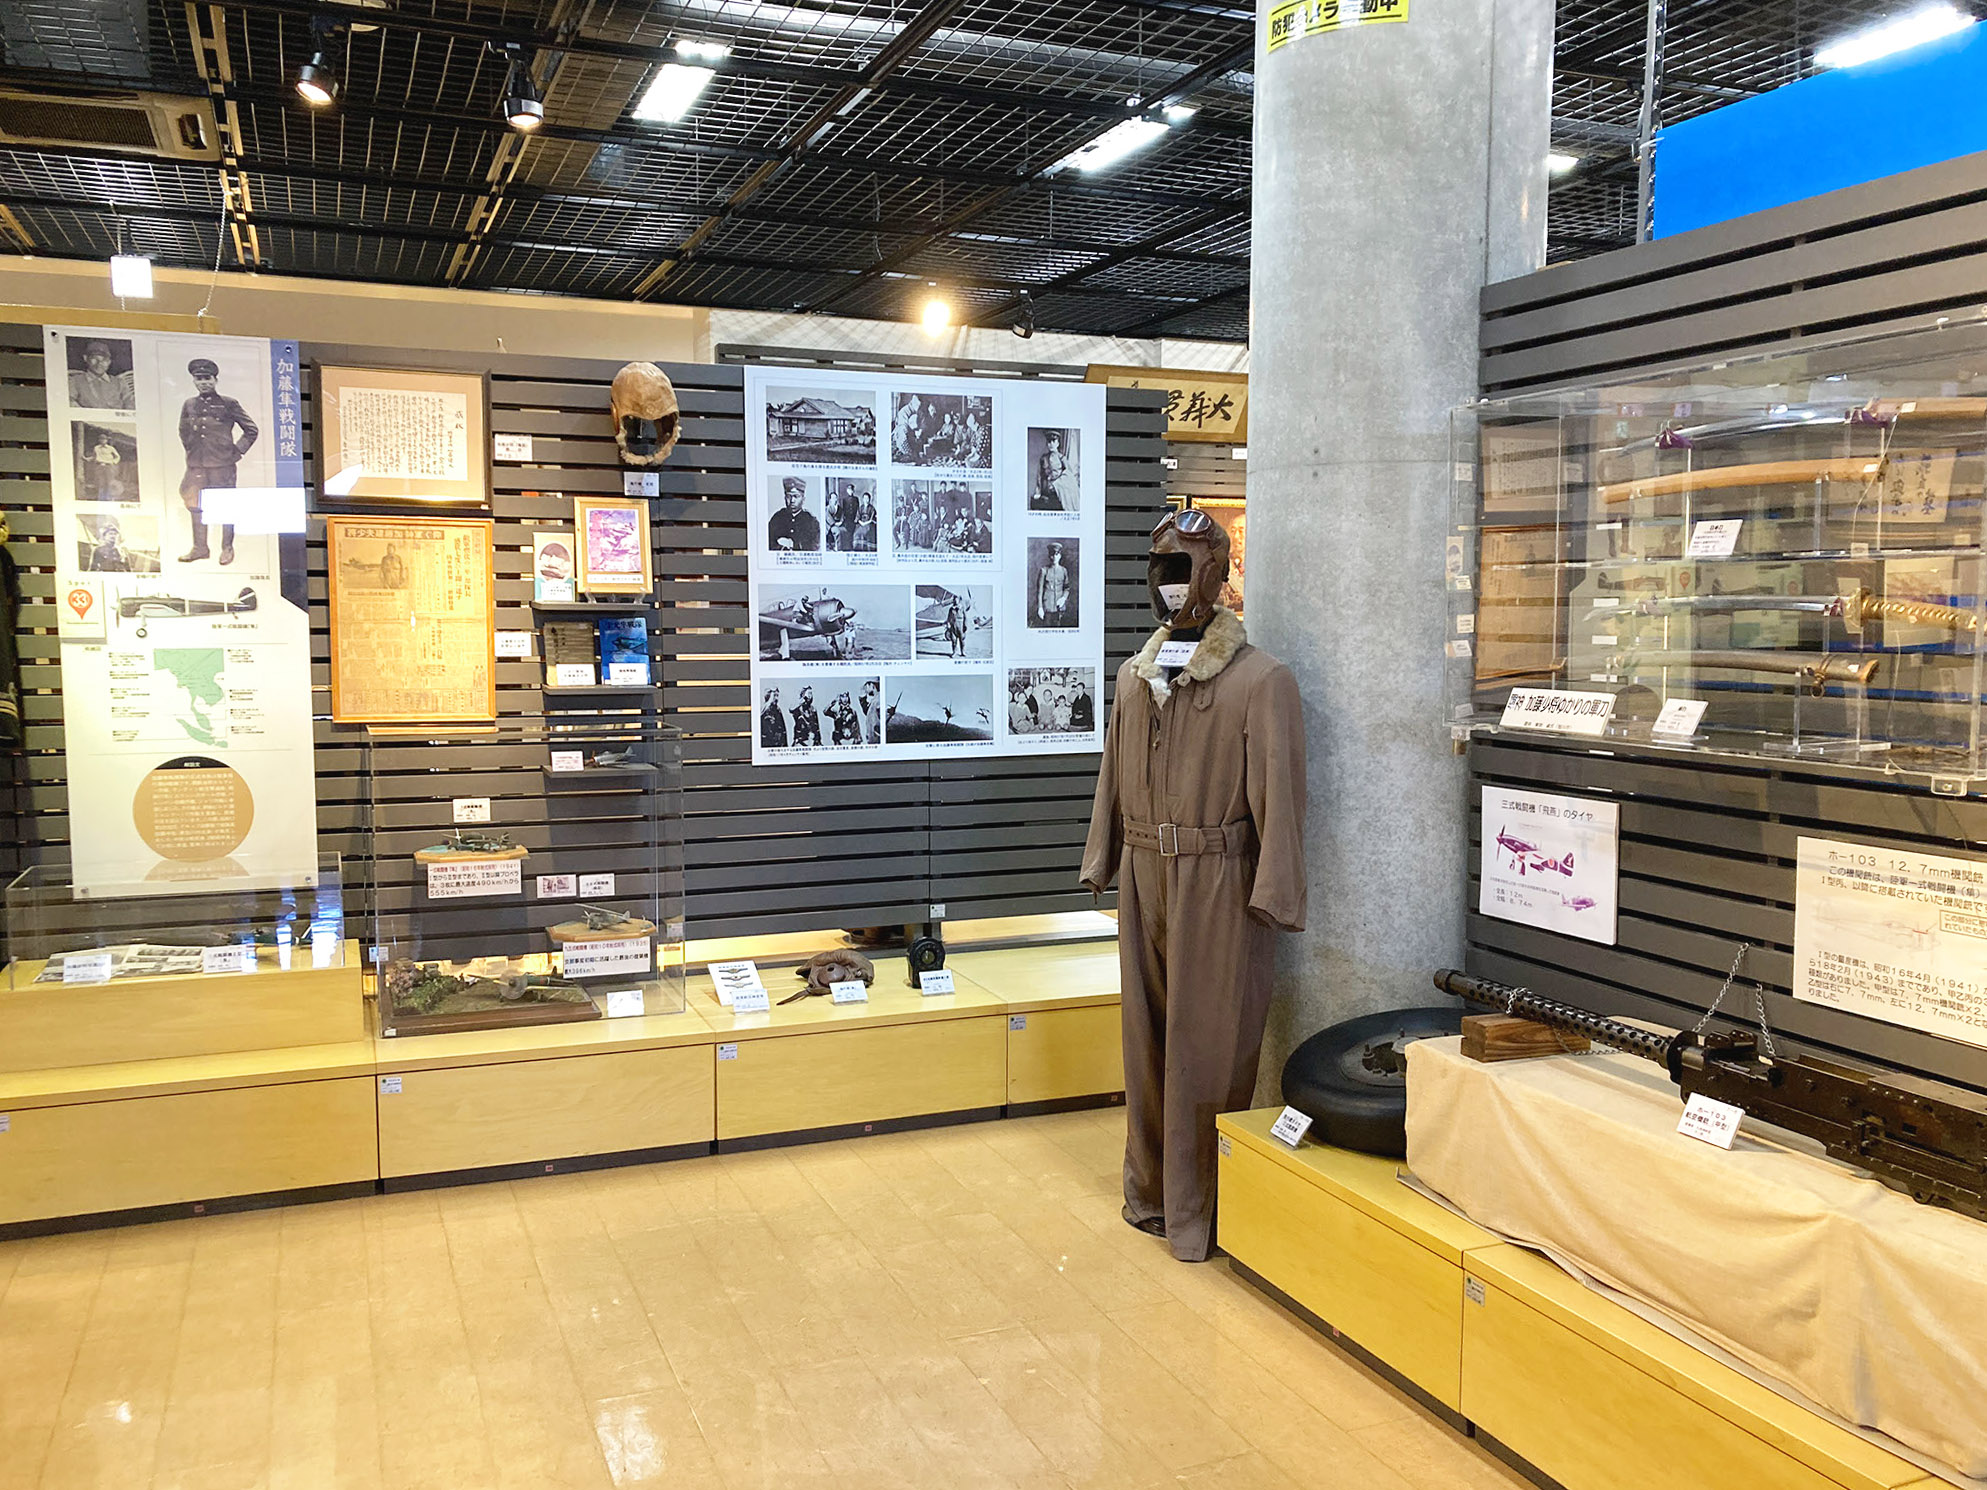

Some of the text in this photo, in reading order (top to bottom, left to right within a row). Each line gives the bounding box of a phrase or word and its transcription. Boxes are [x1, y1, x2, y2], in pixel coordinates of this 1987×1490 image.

[276, 358, 298, 457] 加藤隼戦闘隊
[73, 592, 88, 608] 33
[1525, 695, 1610, 718] 加藤少将ゆかりの軍刀
[1501, 799, 1594, 822] 三式戦闘機「飛燕」のタイヤ
